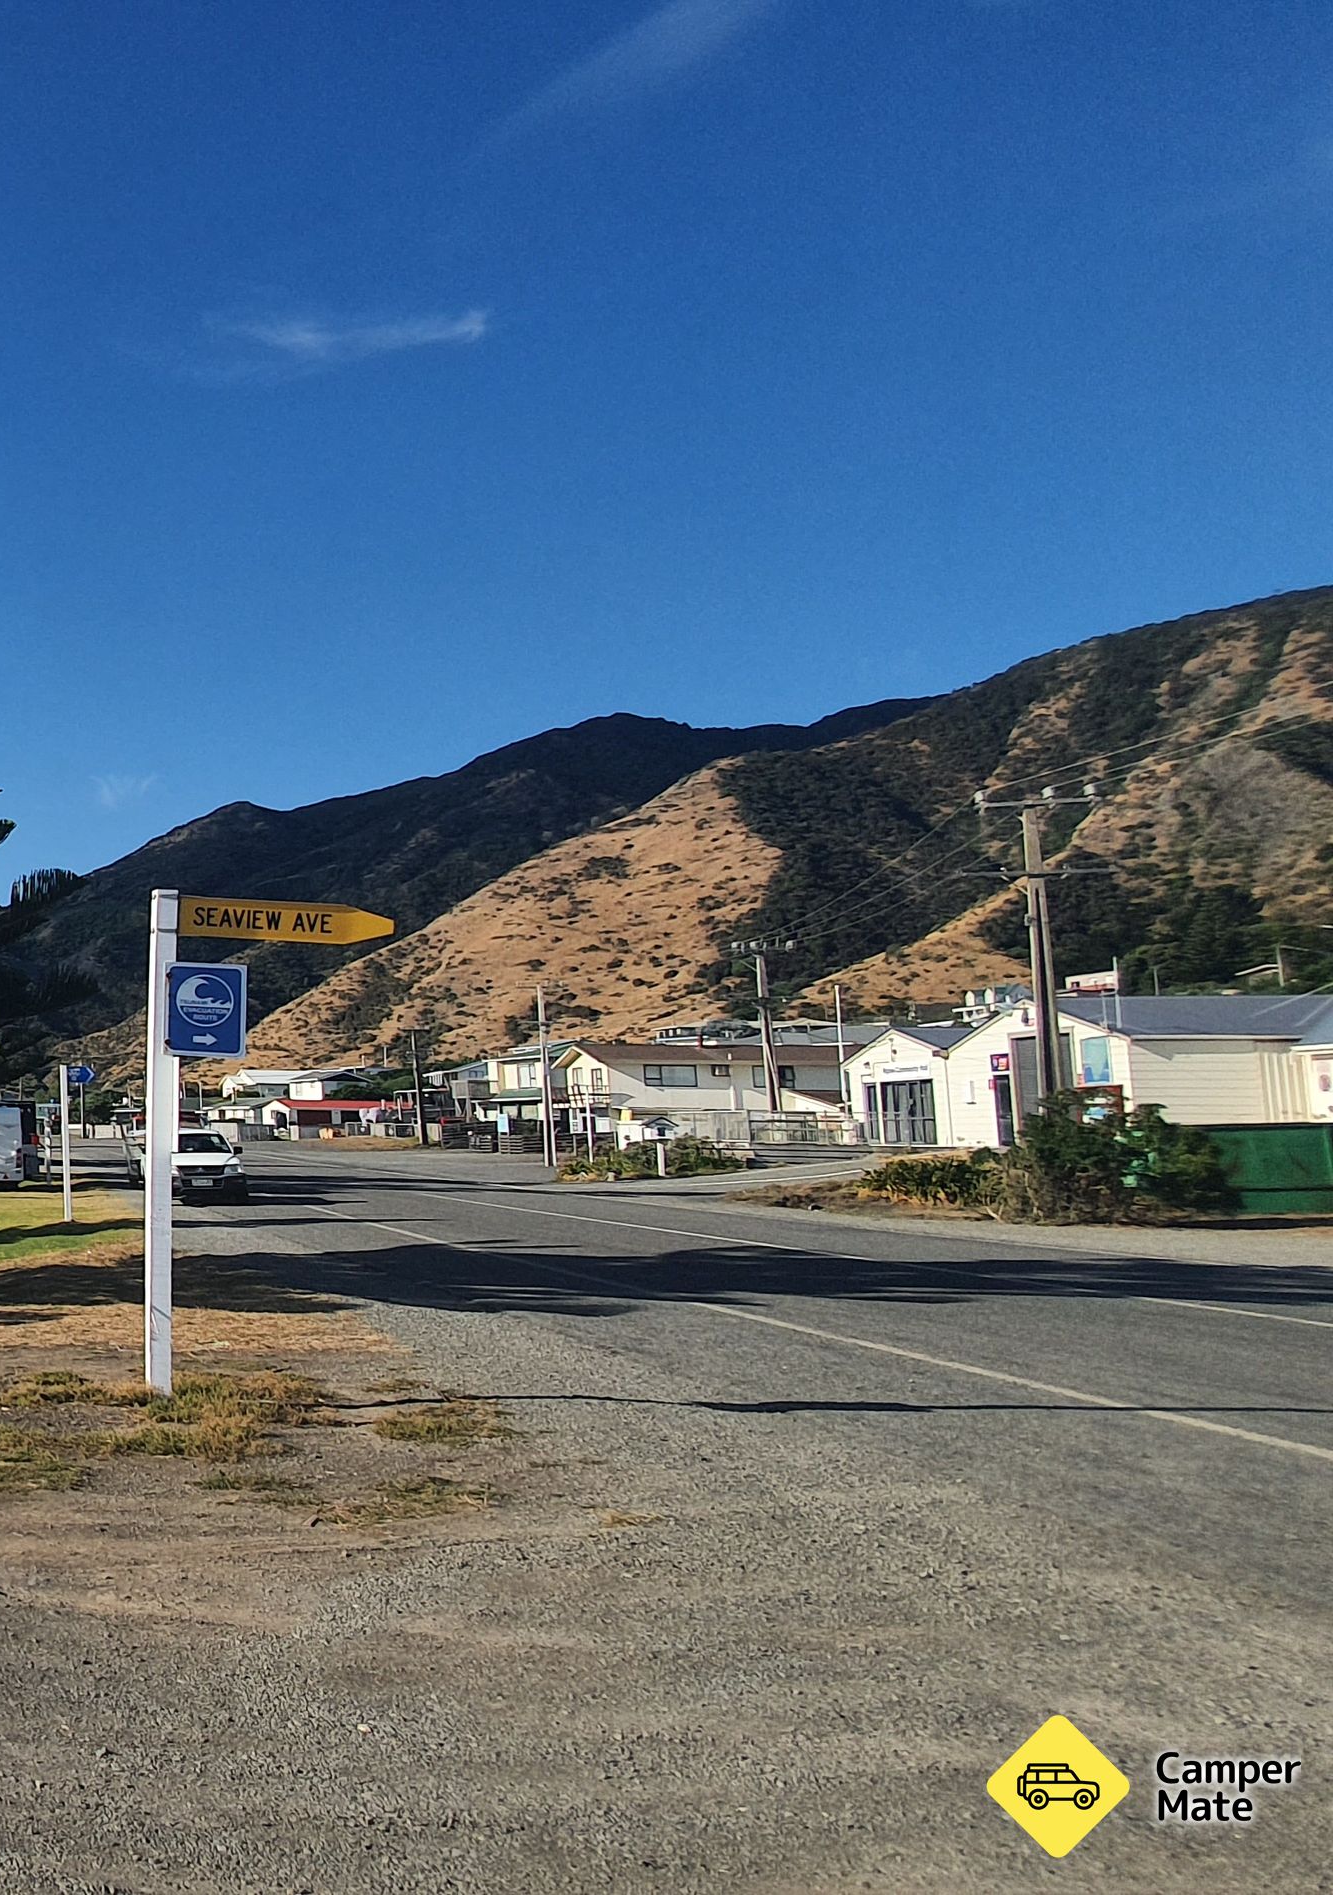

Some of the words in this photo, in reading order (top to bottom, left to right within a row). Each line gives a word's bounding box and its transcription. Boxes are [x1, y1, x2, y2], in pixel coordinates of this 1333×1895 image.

[193, 906, 282, 931] SEAVIEW
[292, 912, 333, 934] AVE
[183, 1006, 229, 1015] EVACUATION
